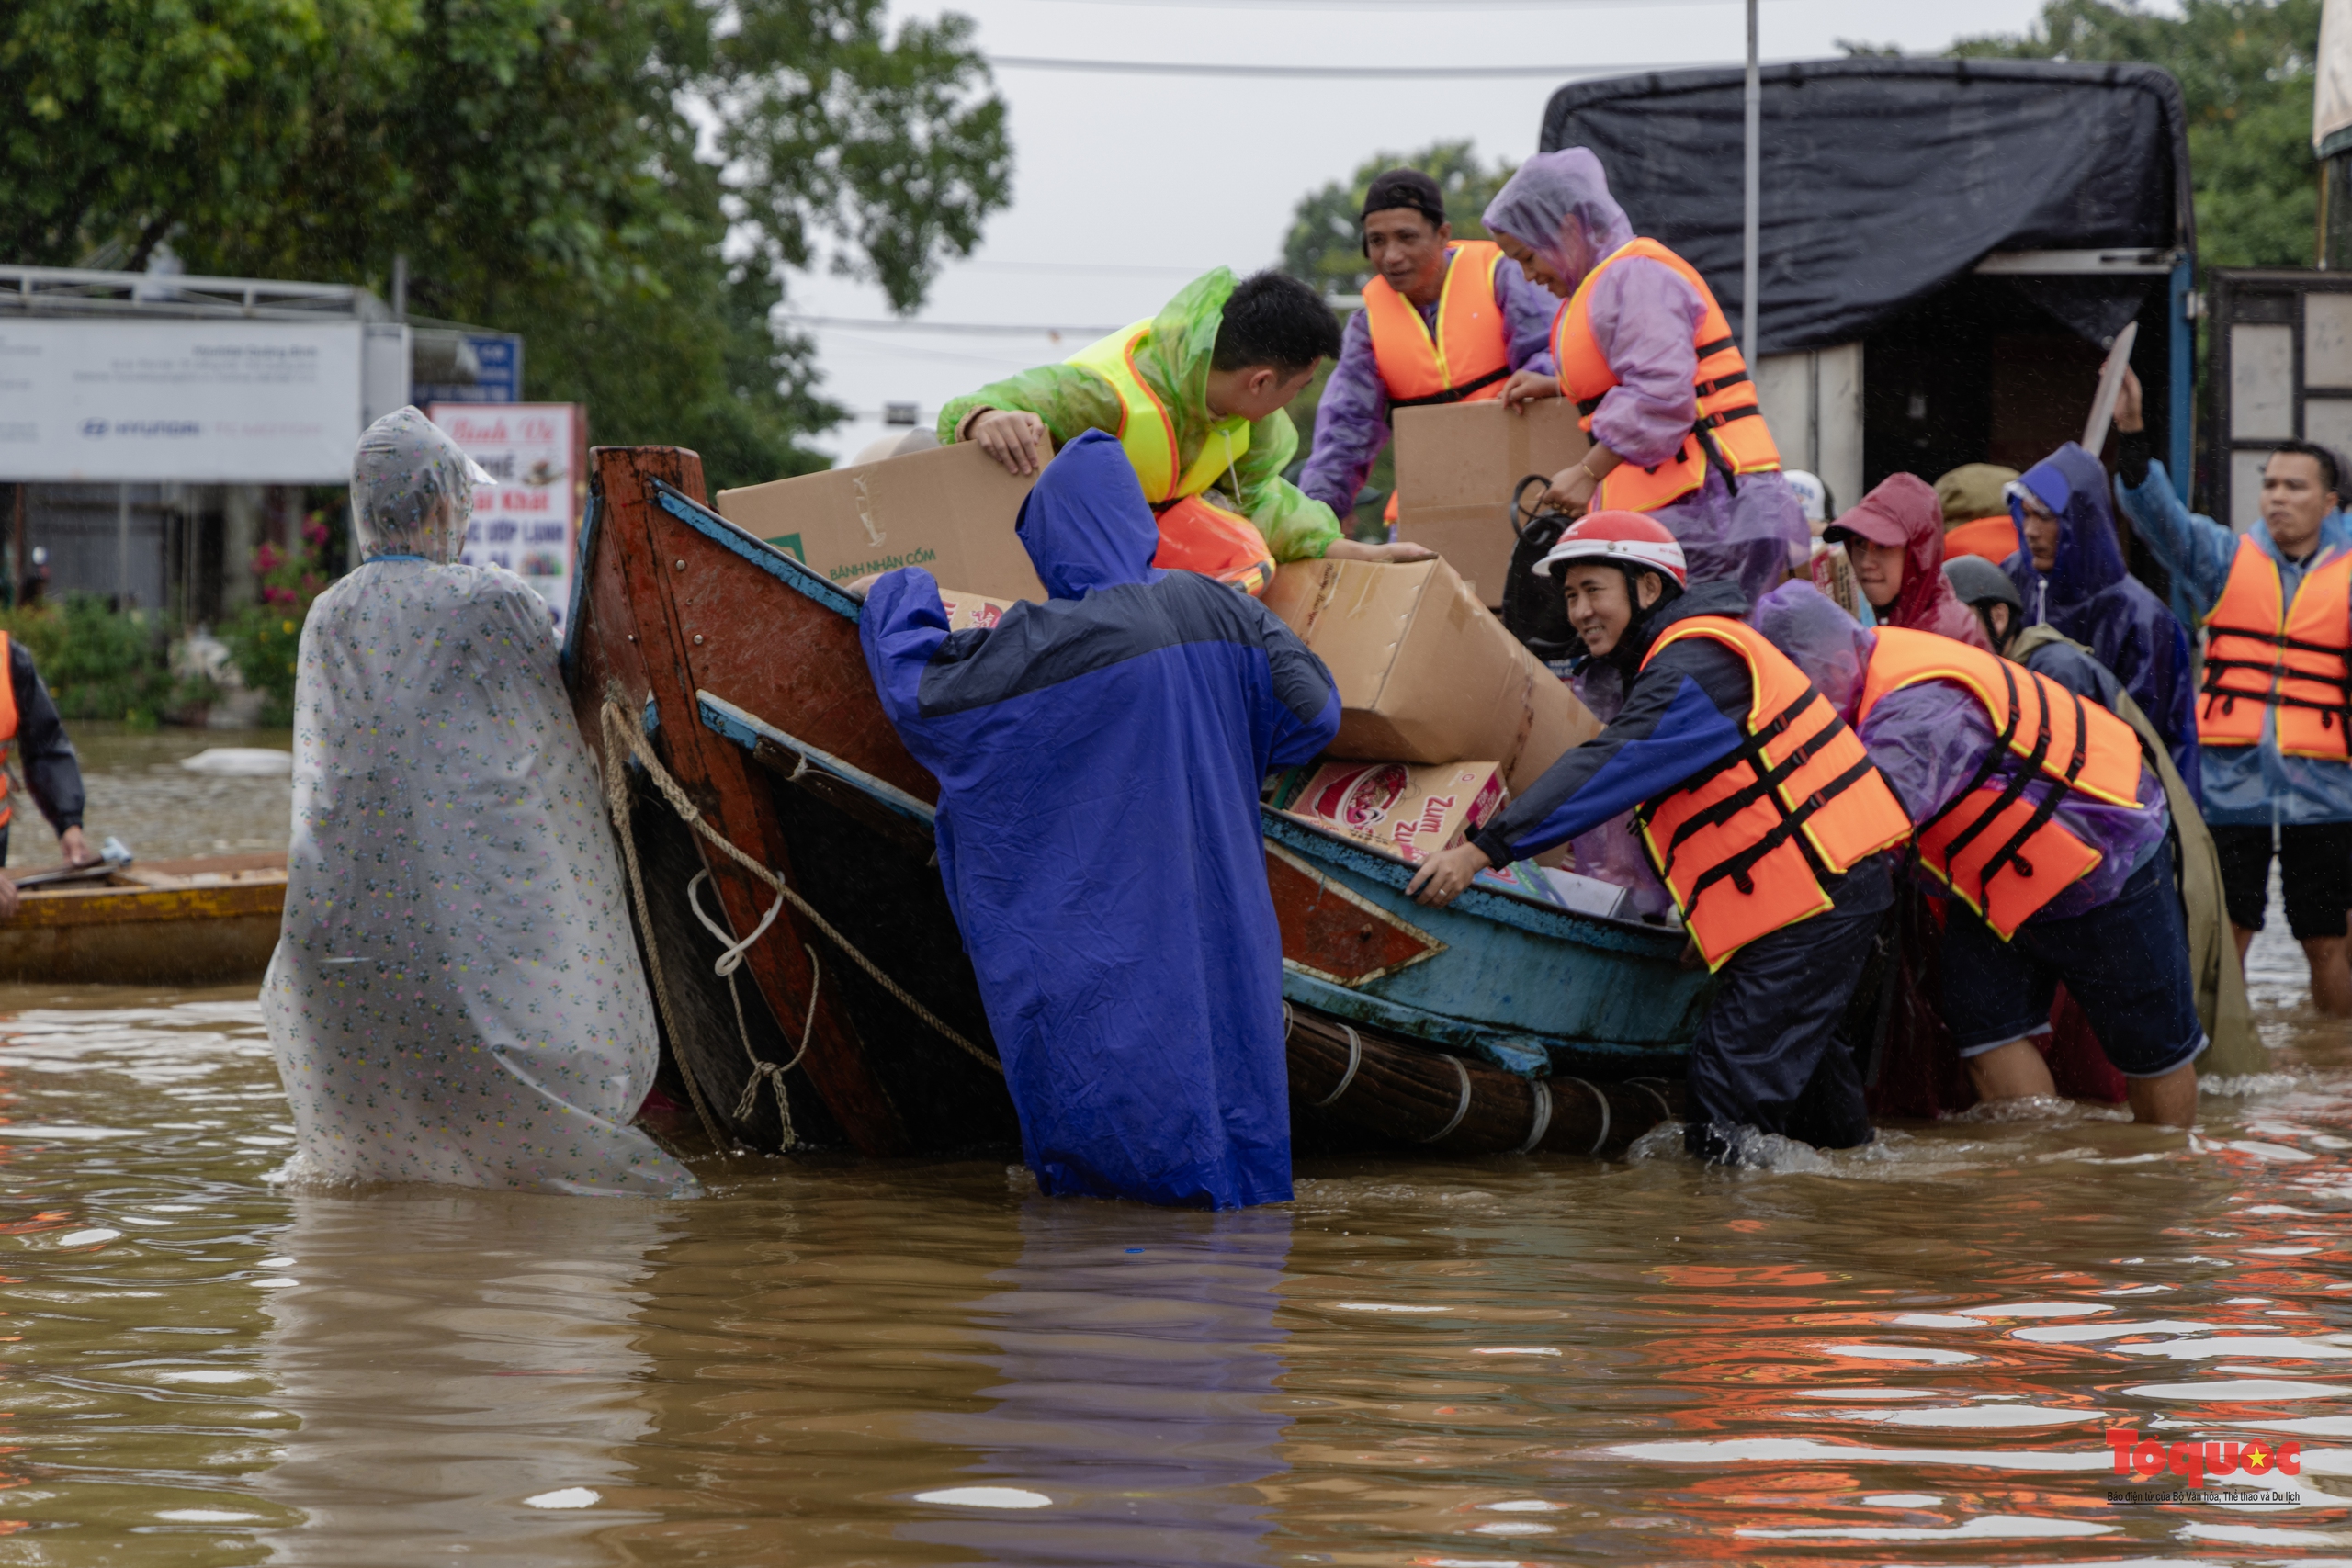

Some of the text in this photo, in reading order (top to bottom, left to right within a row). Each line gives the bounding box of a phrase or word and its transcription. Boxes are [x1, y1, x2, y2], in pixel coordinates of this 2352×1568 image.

[829, 562, 865, 581] BÁNH
[905, 547, 937, 567] CỐM
[1419, 795, 1456, 834] Zum
[1394, 820, 1419, 846] Zu
